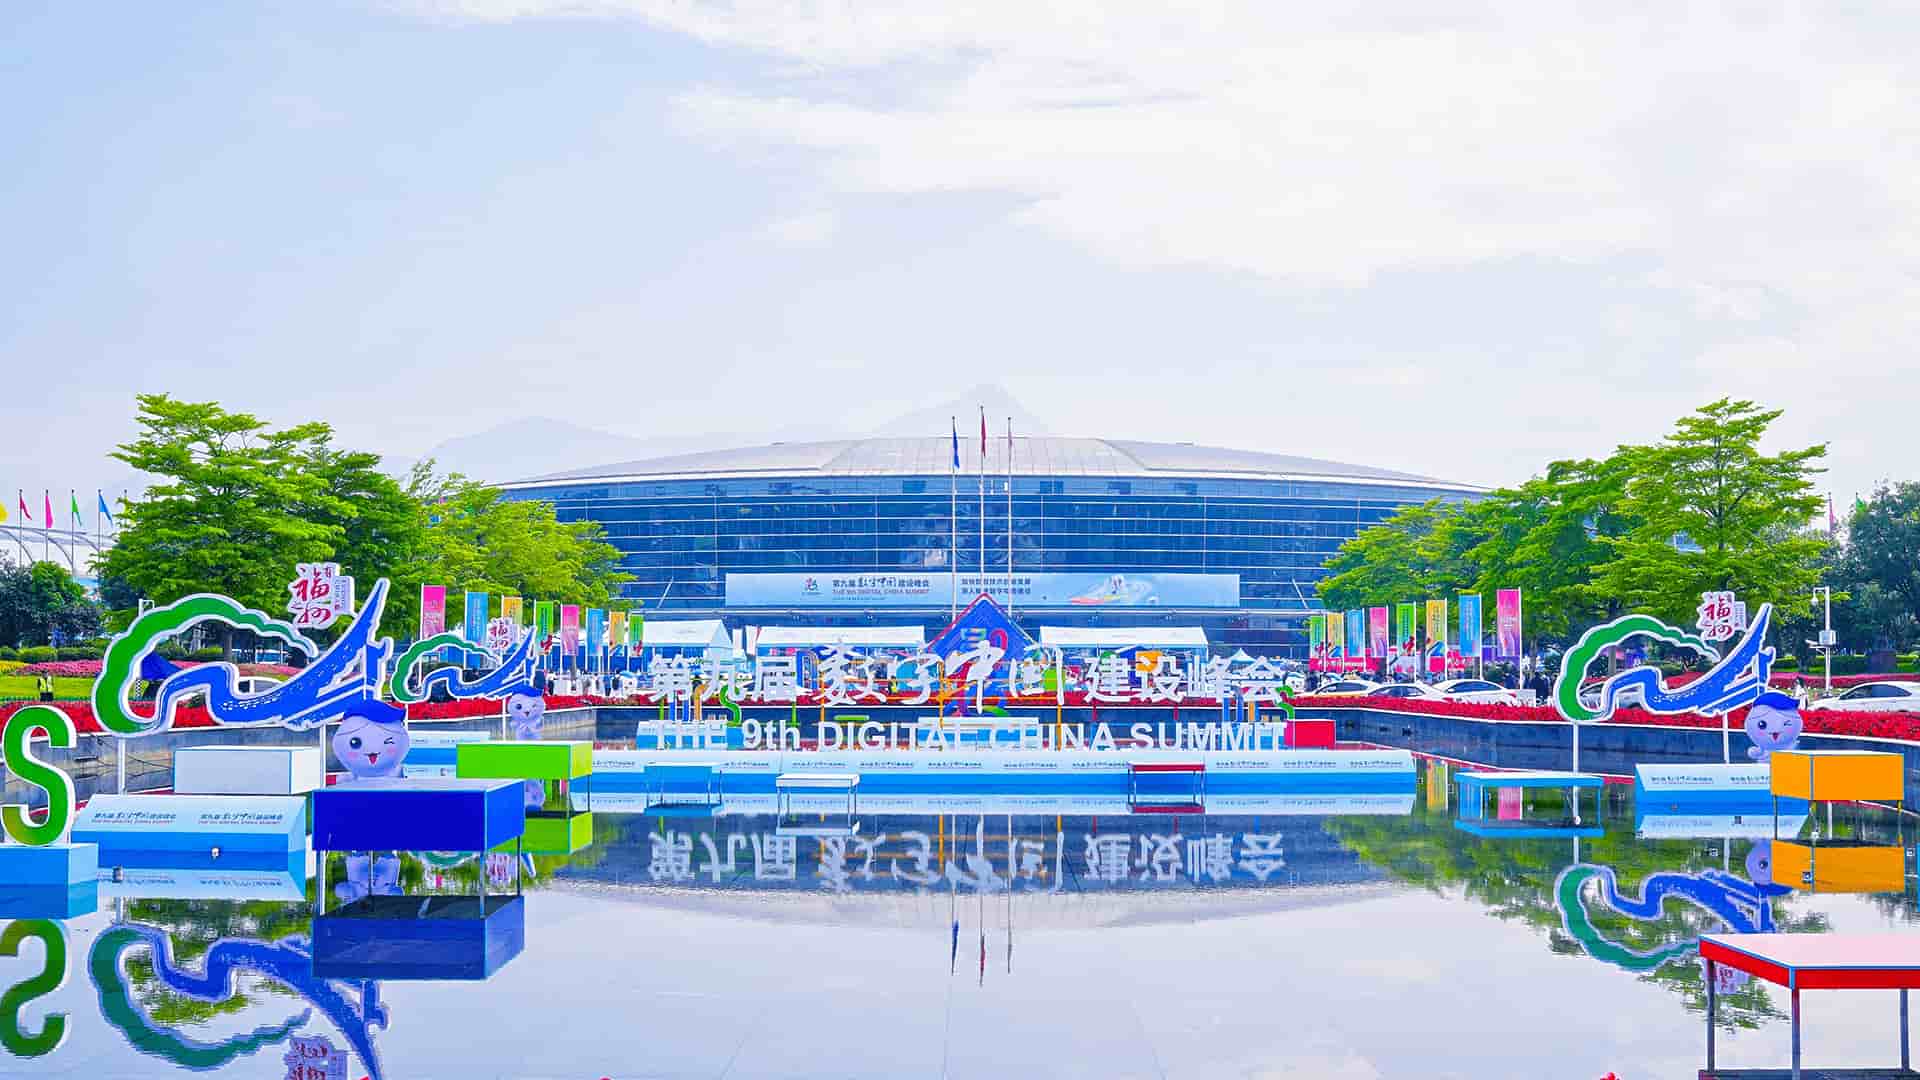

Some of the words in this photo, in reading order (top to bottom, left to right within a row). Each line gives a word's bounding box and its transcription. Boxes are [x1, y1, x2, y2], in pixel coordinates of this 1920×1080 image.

[1, 706, 77, 846] S
[649, 719, 728, 750] THE
[742, 718, 801, 750] 9th
[816, 720, 974, 750] DIGITAL
[989, 720, 1116, 750] CHINA
[1129, 720, 1288, 750] SUMMIT
